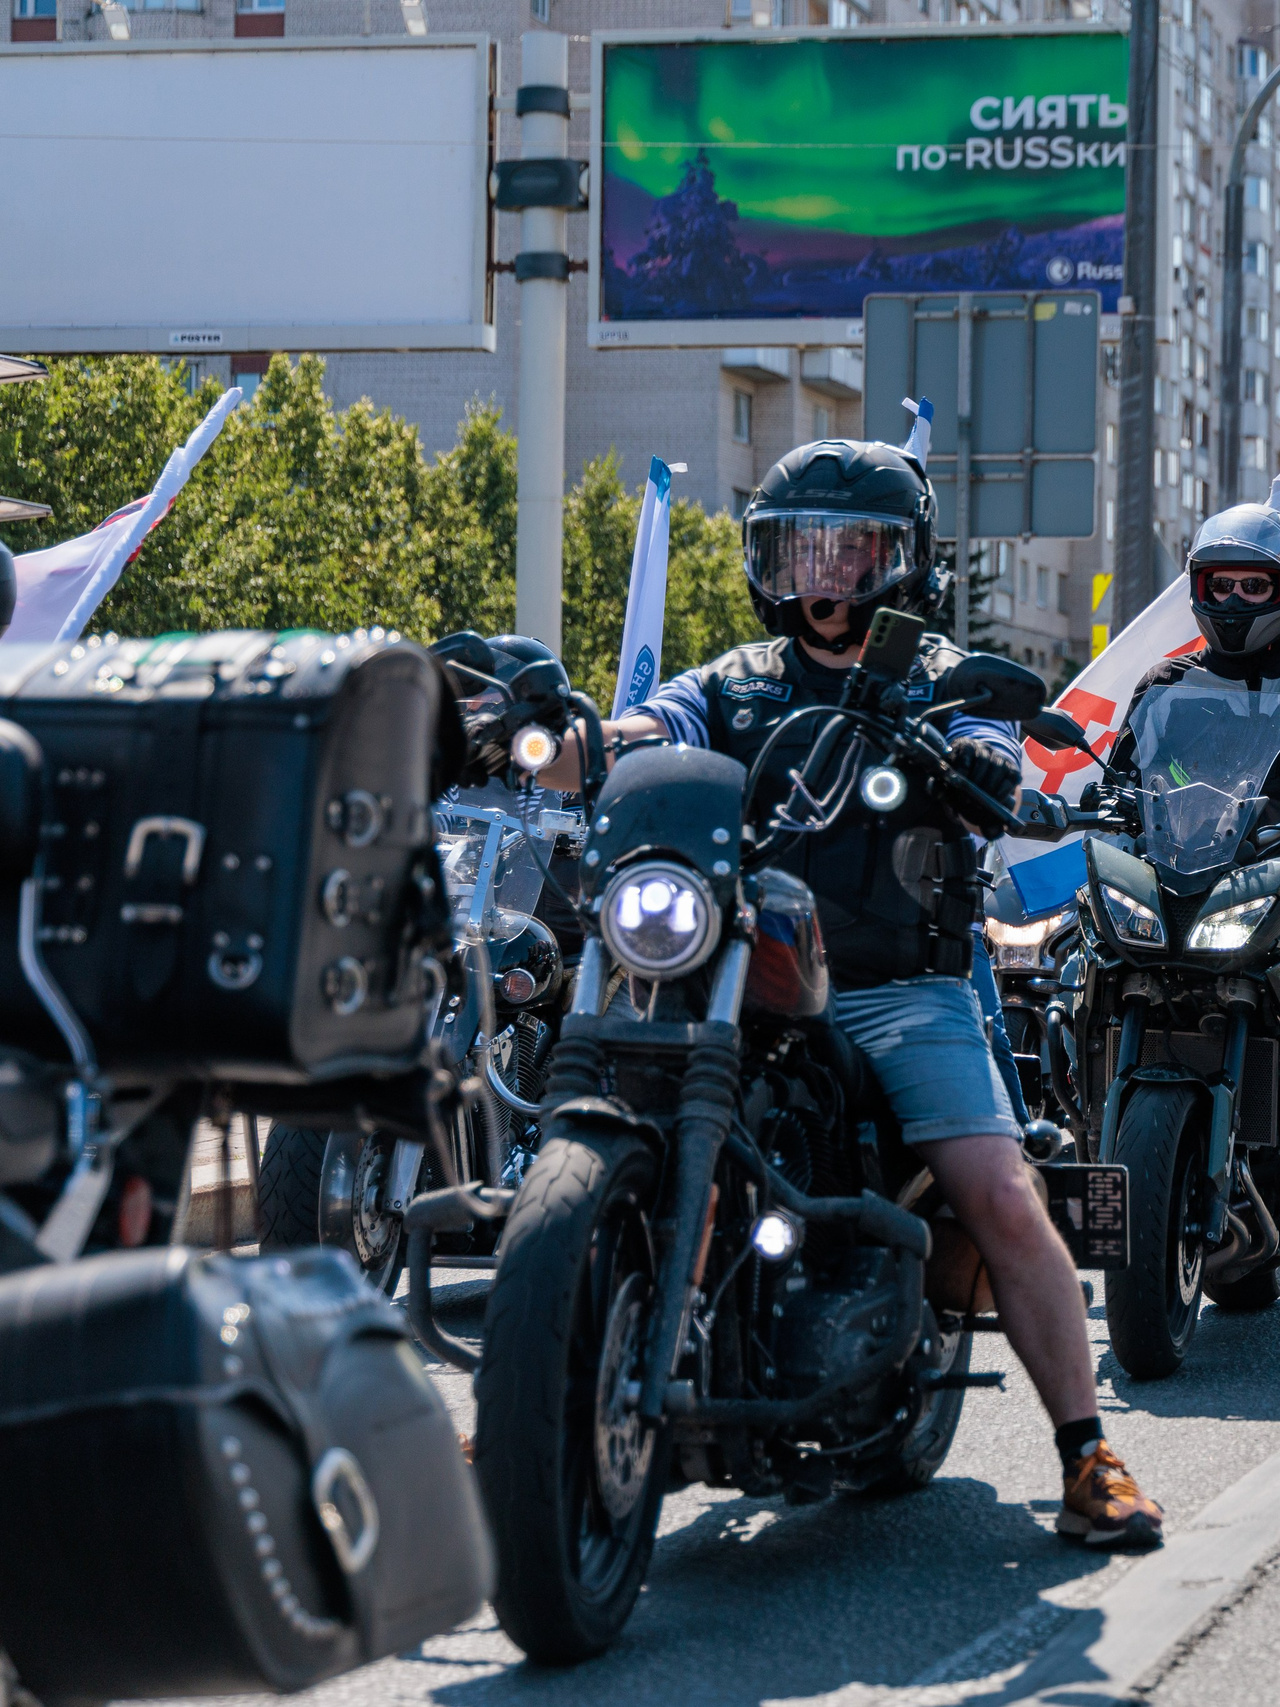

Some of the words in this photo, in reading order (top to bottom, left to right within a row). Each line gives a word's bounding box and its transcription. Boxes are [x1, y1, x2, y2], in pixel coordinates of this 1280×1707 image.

[181, 334, 221, 342] POSTER
[786, 489, 852, 500] LS2
[729, 681, 783, 696] SHARKS
